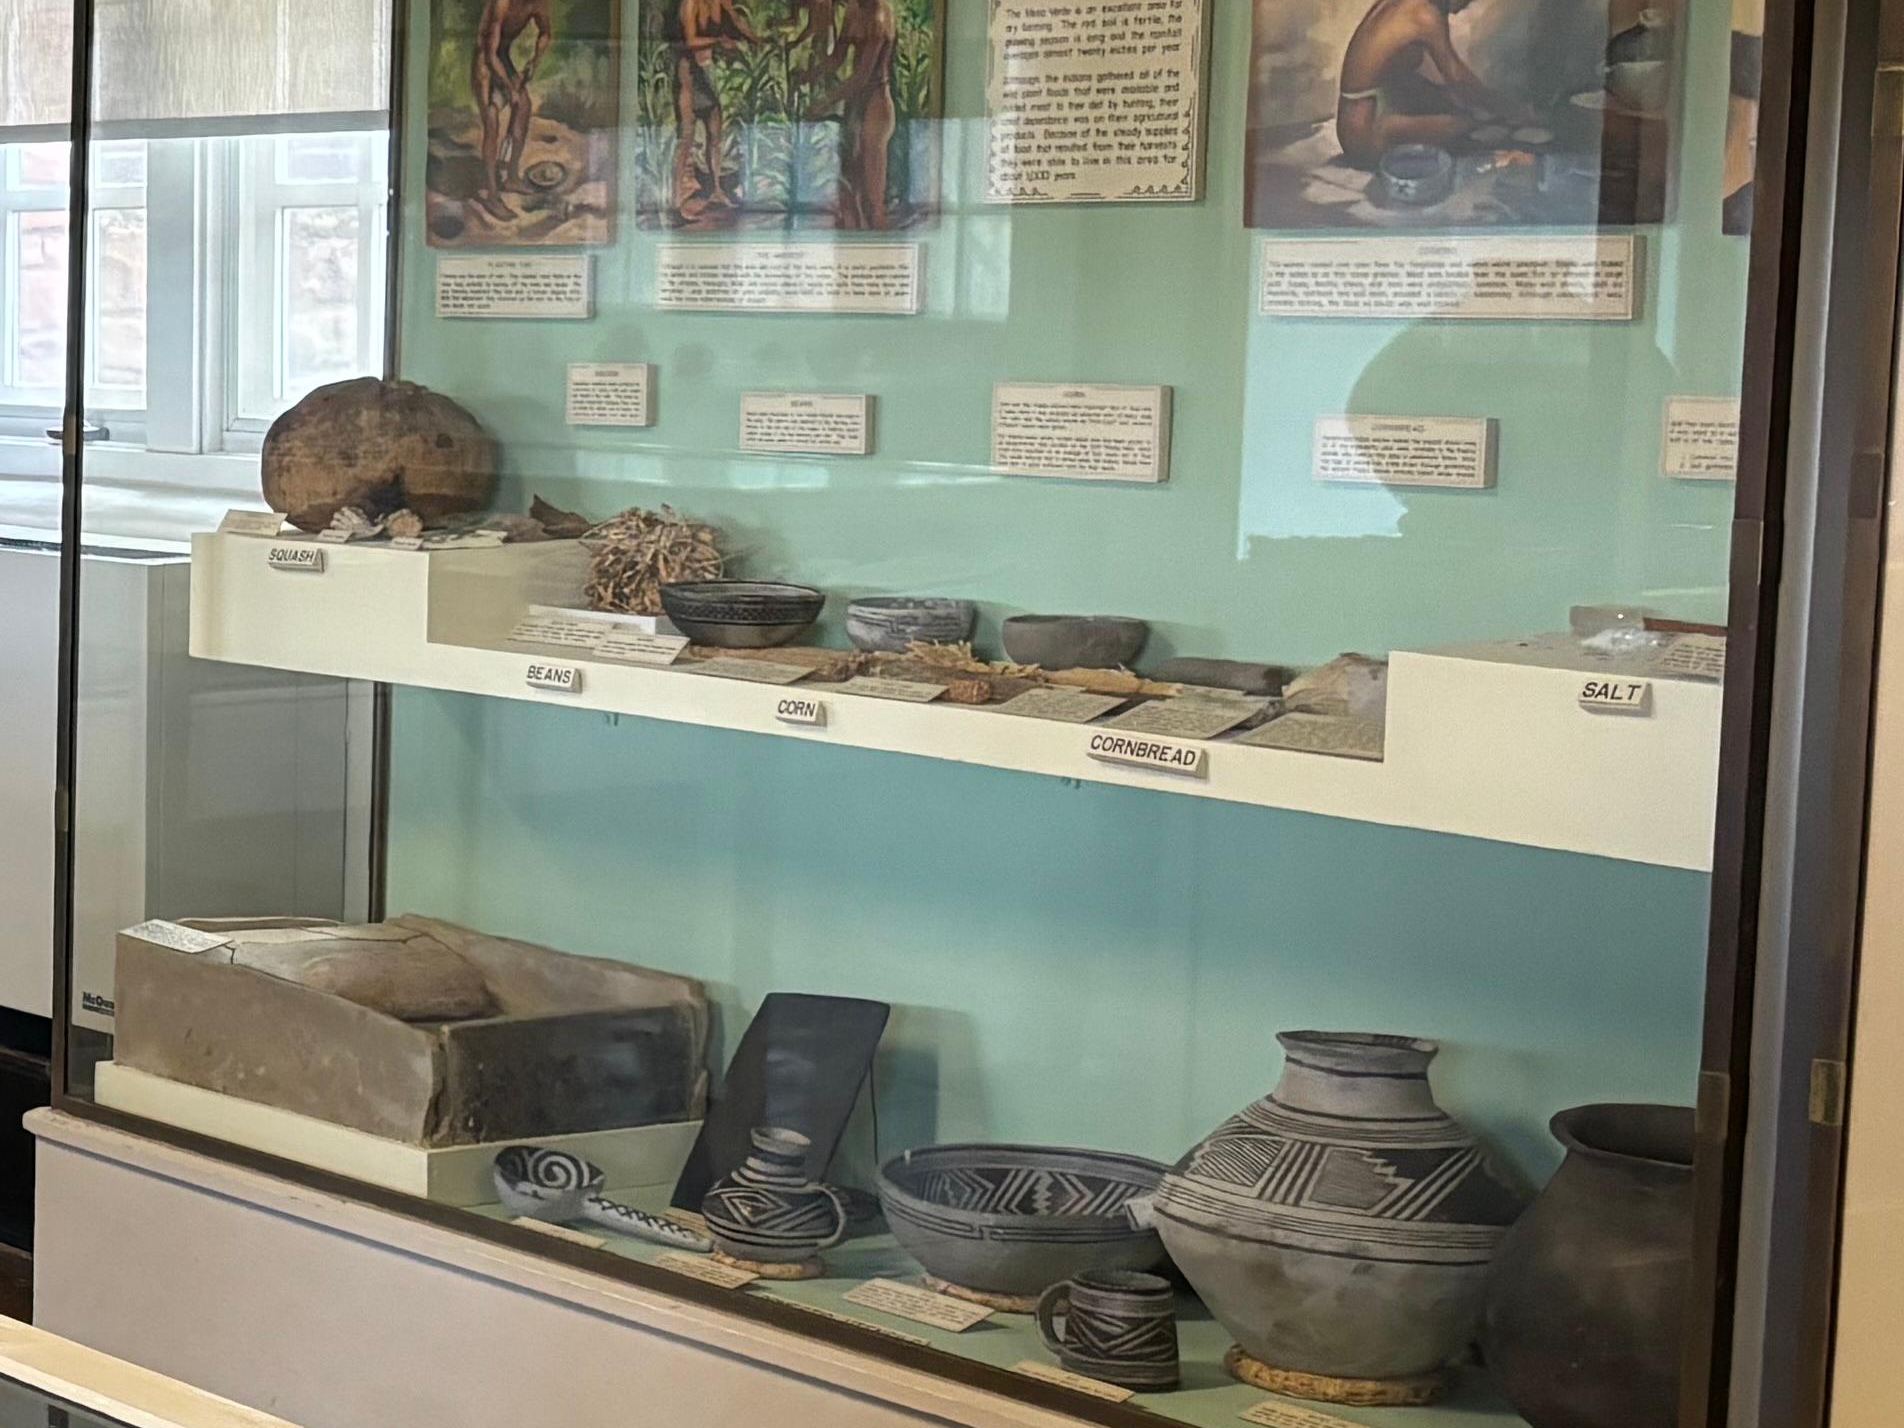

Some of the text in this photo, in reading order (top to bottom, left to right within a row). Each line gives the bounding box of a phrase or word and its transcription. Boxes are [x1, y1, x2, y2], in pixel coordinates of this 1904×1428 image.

[268, 547, 315, 564] SQUASH
[526, 664, 571, 684] BEANS
[1582, 681, 1641, 701] SALT
[778, 699, 816, 718] CORN
[1090, 733, 1197, 768] CORNBREAD
